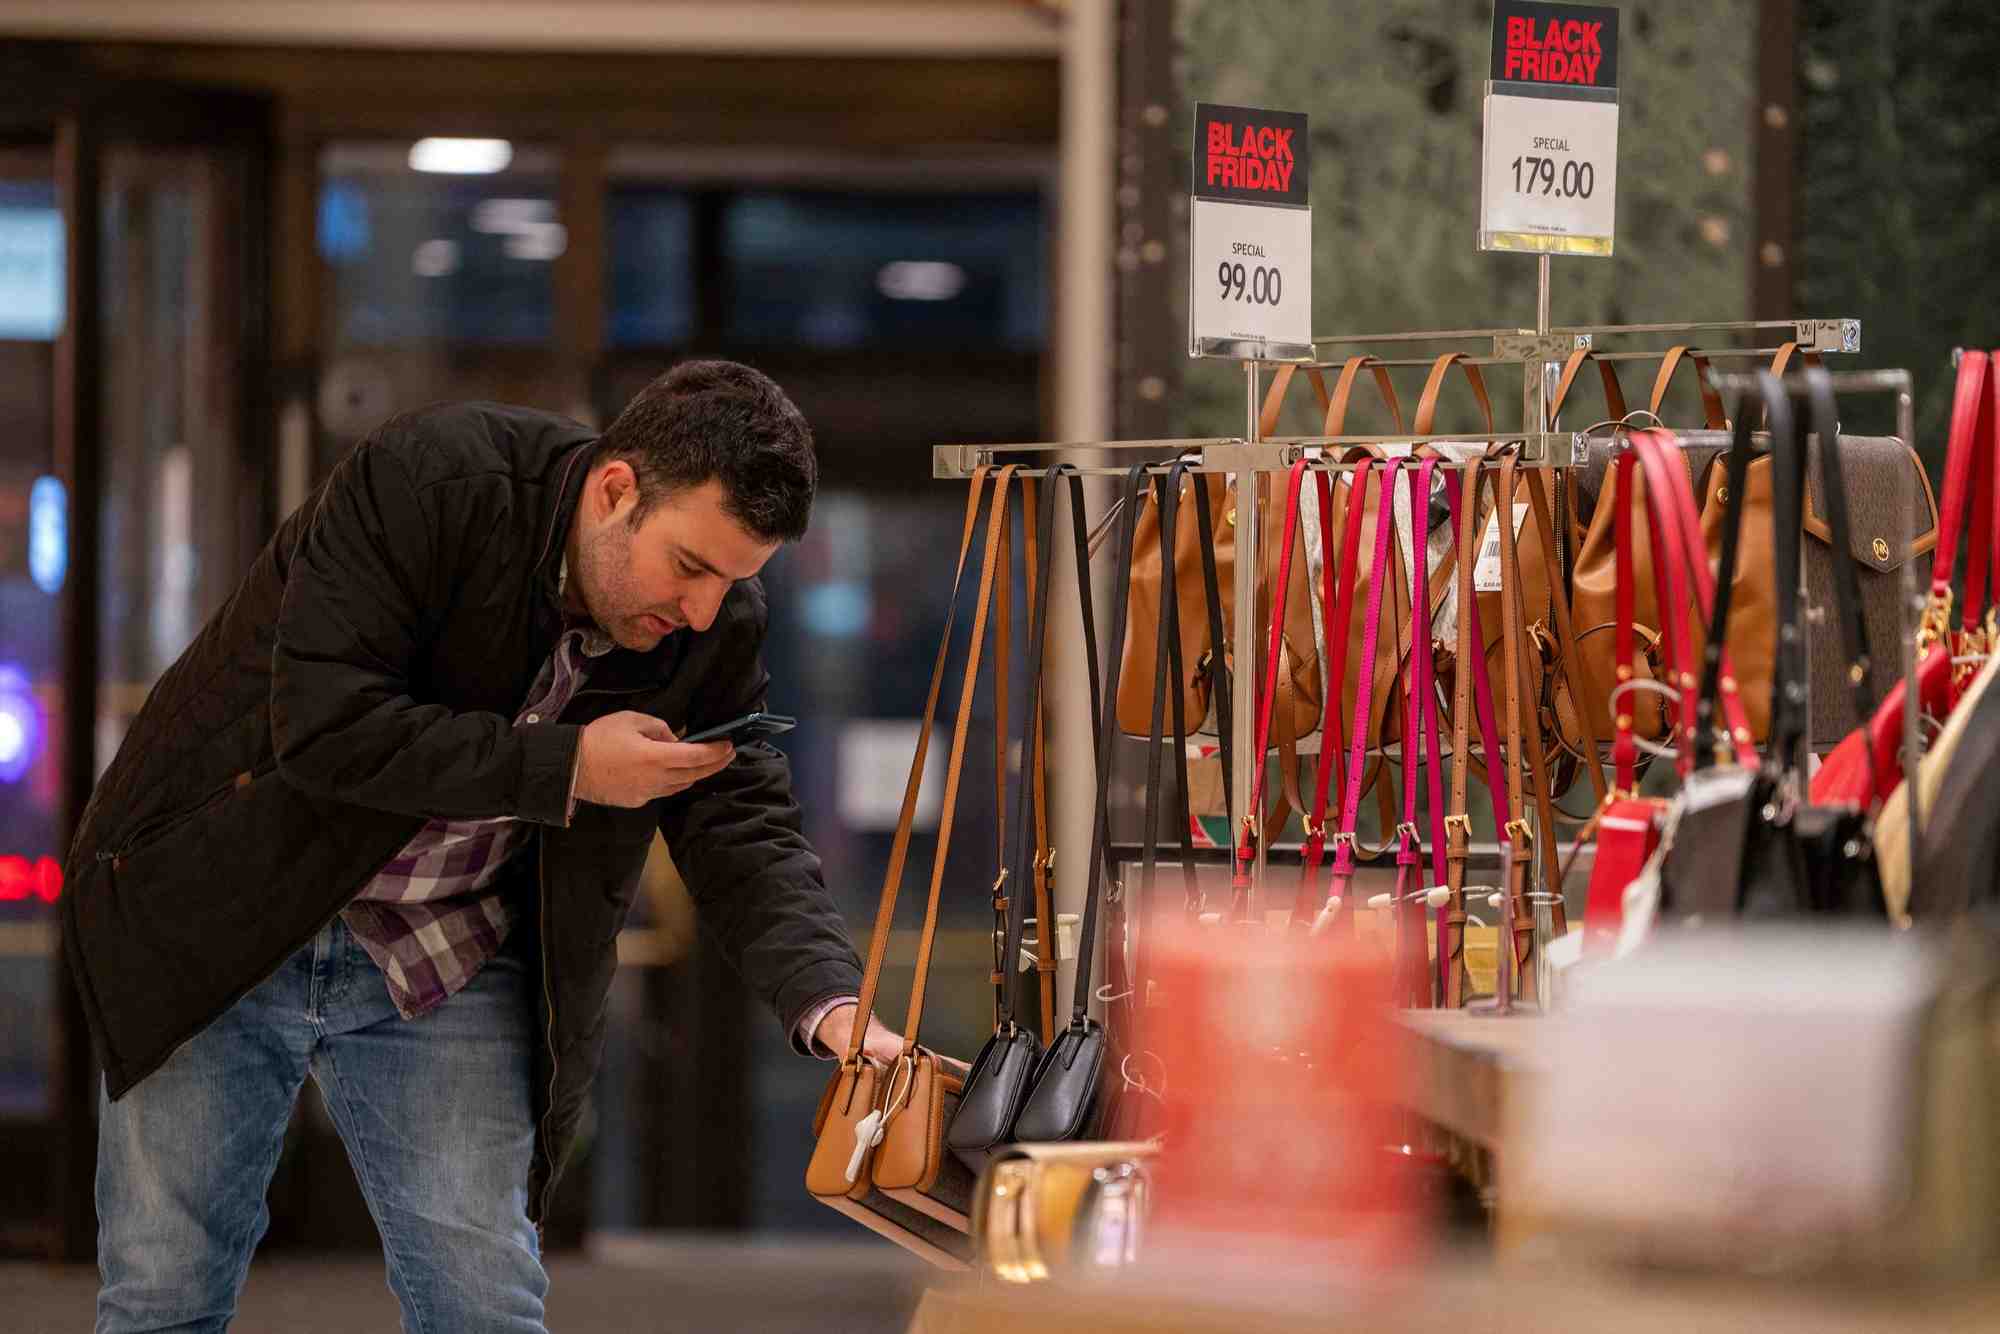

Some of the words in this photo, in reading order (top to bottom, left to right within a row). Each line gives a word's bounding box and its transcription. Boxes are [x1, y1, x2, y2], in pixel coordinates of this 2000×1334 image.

[1506, 15, 1602, 53] BLACK
[1504, 49, 1602, 84] FRIDAY
[1207, 120, 1295, 161] BLACK
[1533, 136, 1570, 152] SPECIAL
[1207, 155, 1294, 193] FRIDAY
[1511, 155, 1595, 200] 179.00
[1232, 242, 1266, 258] SPECIAL
[1218, 261, 1282, 306] 99.00
